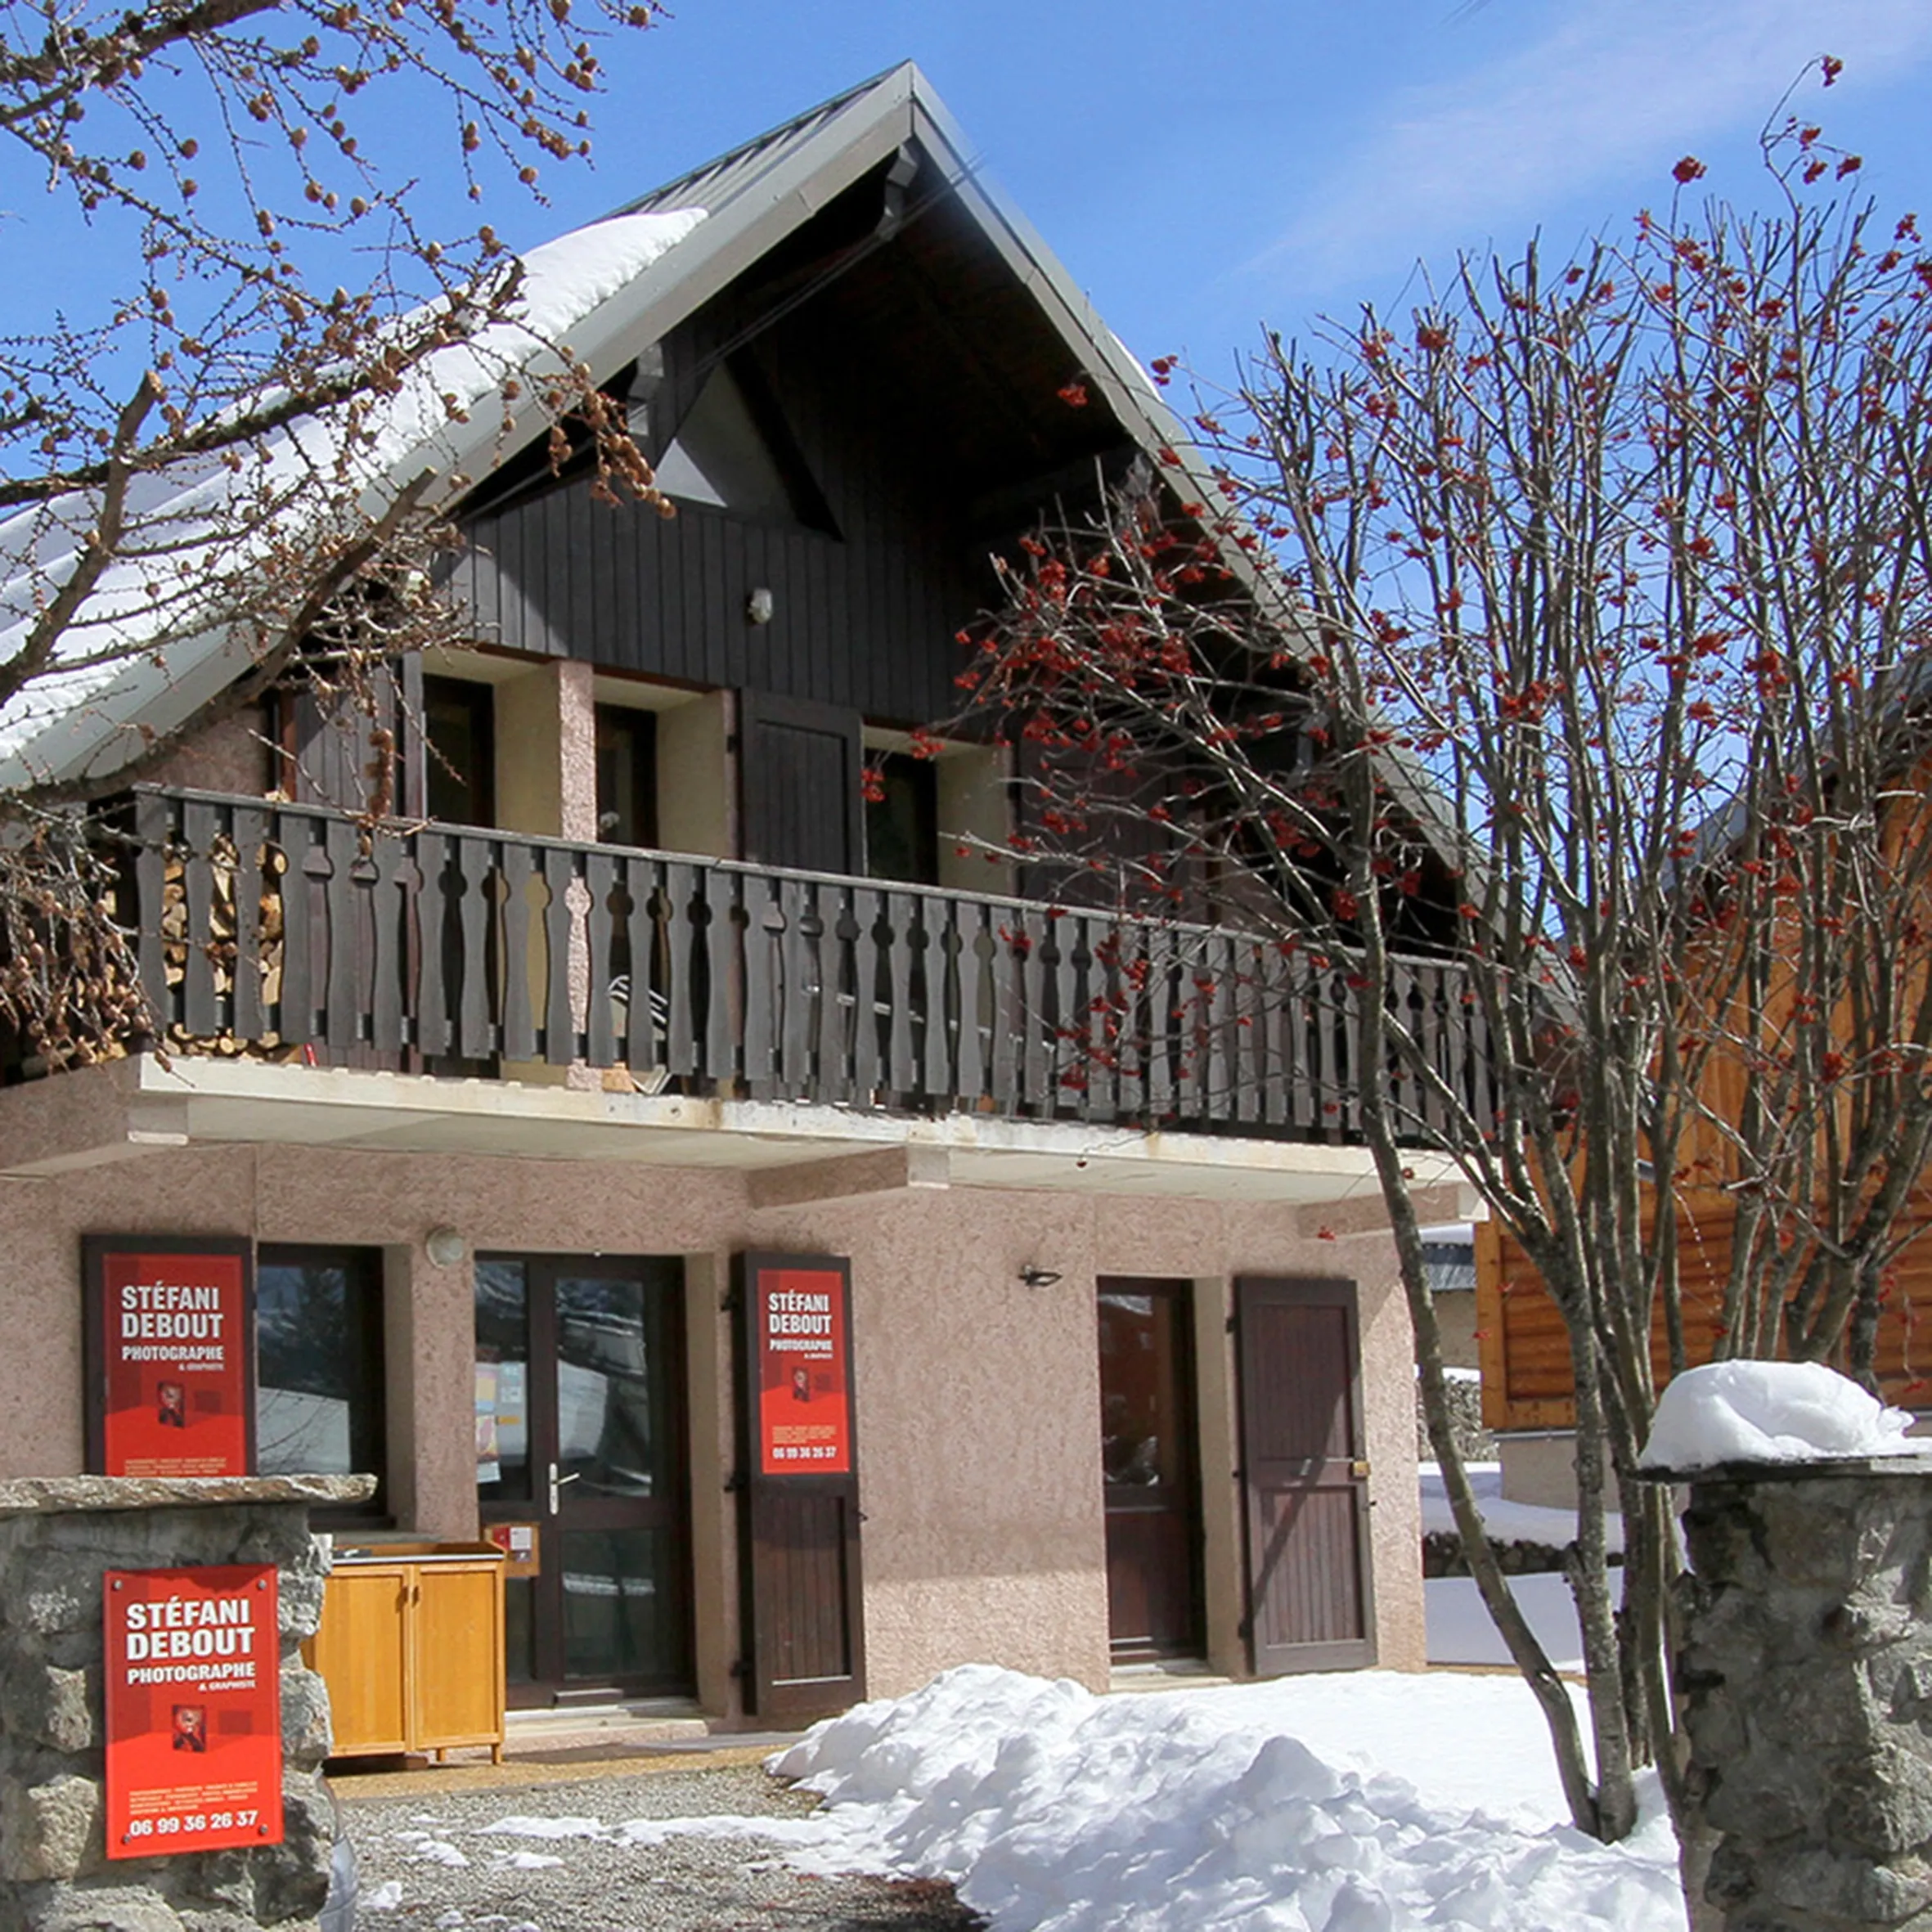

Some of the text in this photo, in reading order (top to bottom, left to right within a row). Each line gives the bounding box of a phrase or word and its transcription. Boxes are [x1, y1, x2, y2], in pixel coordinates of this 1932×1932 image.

[121, 1280, 220, 1310] STÉFANI
[769, 1288, 829, 1312] STÉFANI
[121, 1312, 224, 1338] DEBOUT
[769, 1313, 832, 1334] DEBOUT
[121, 1345, 224, 1361] PHOTOGRAPHE
[125, 1596, 249, 1630] STÉFANI
[126, 1627, 255, 1660] DEBOUT
[127, 1661, 256, 1686] PHOTOGRAPHE
[198, 1683, 207, 1692] &
[129, 1809, 258, 1836] 06 99 36 26 37
